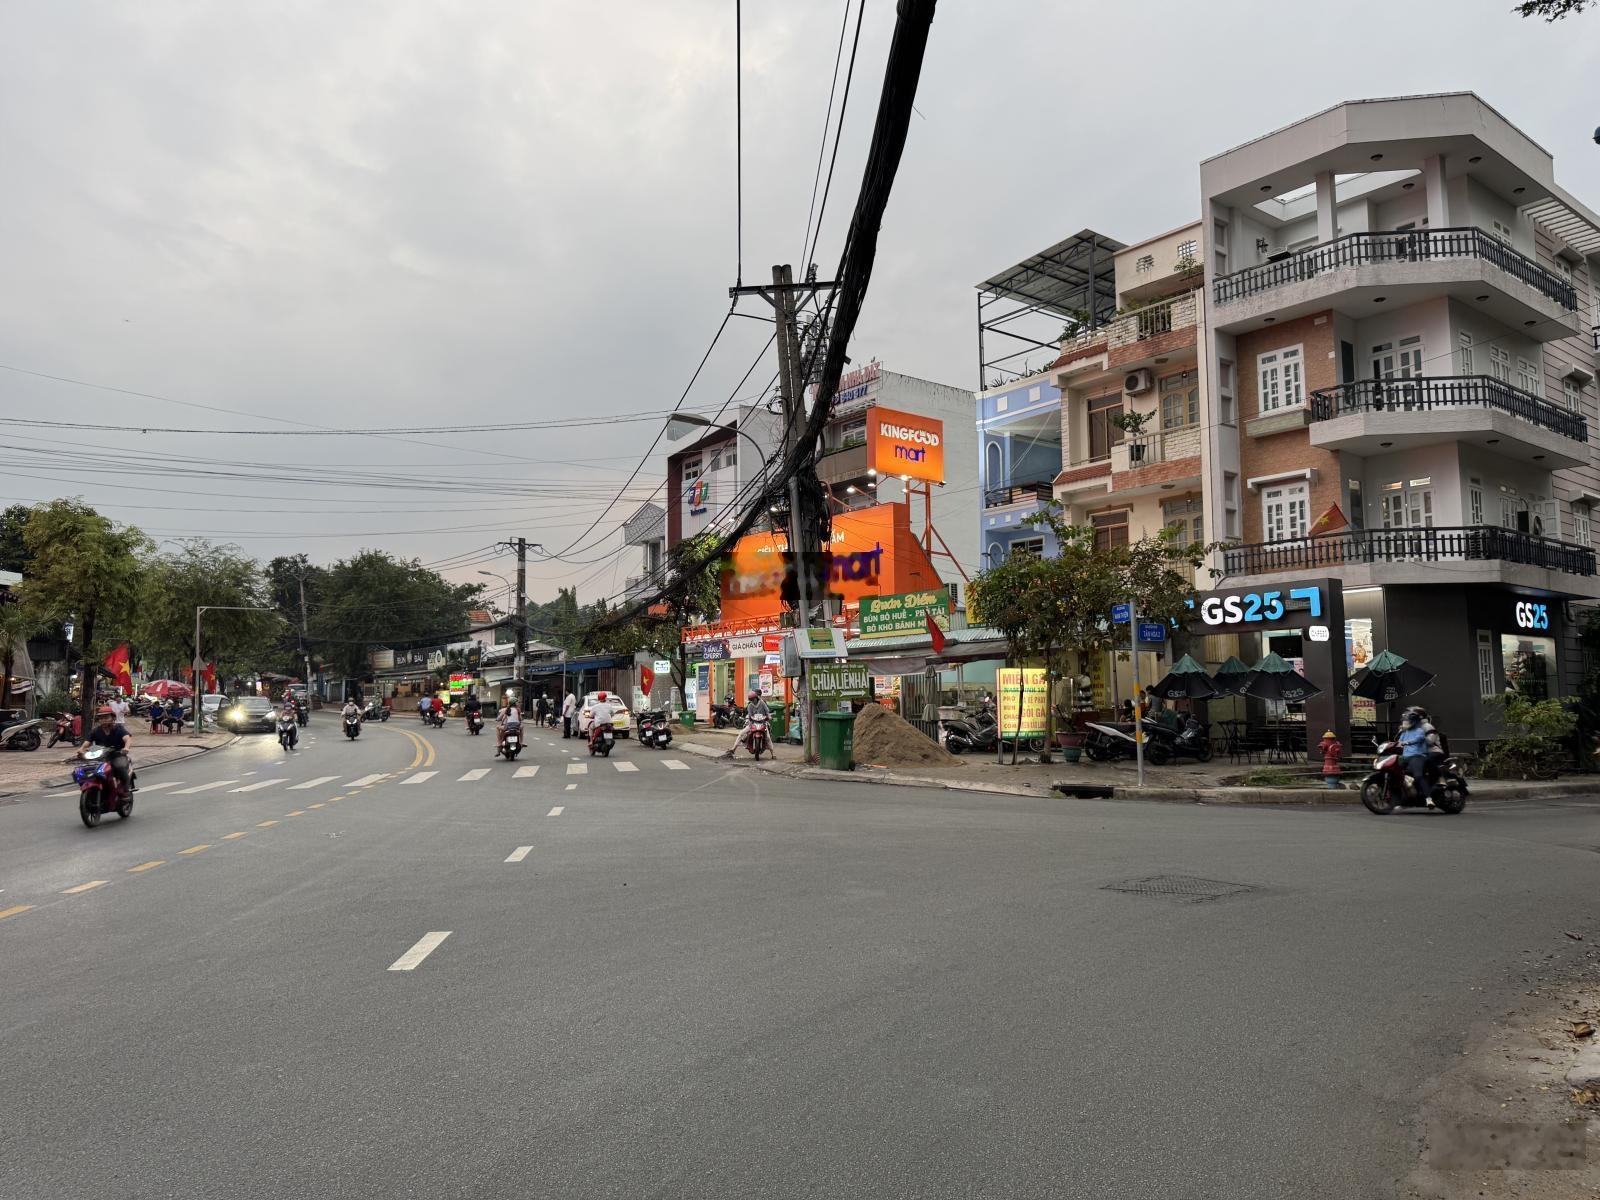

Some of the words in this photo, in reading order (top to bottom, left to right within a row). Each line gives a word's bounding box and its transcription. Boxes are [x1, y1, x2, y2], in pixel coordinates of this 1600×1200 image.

[895, 444, 926, 463] mart
[687, 480, 709, 506] FPT
[1200, 591, 1285, 625] GS25
[1515, 601, 1549, 630] GS25
[878, 622, 893, 631] KHO
[811, 669, 836, 691] CHÙA
[836, 668, 855, 690] LIÊN
